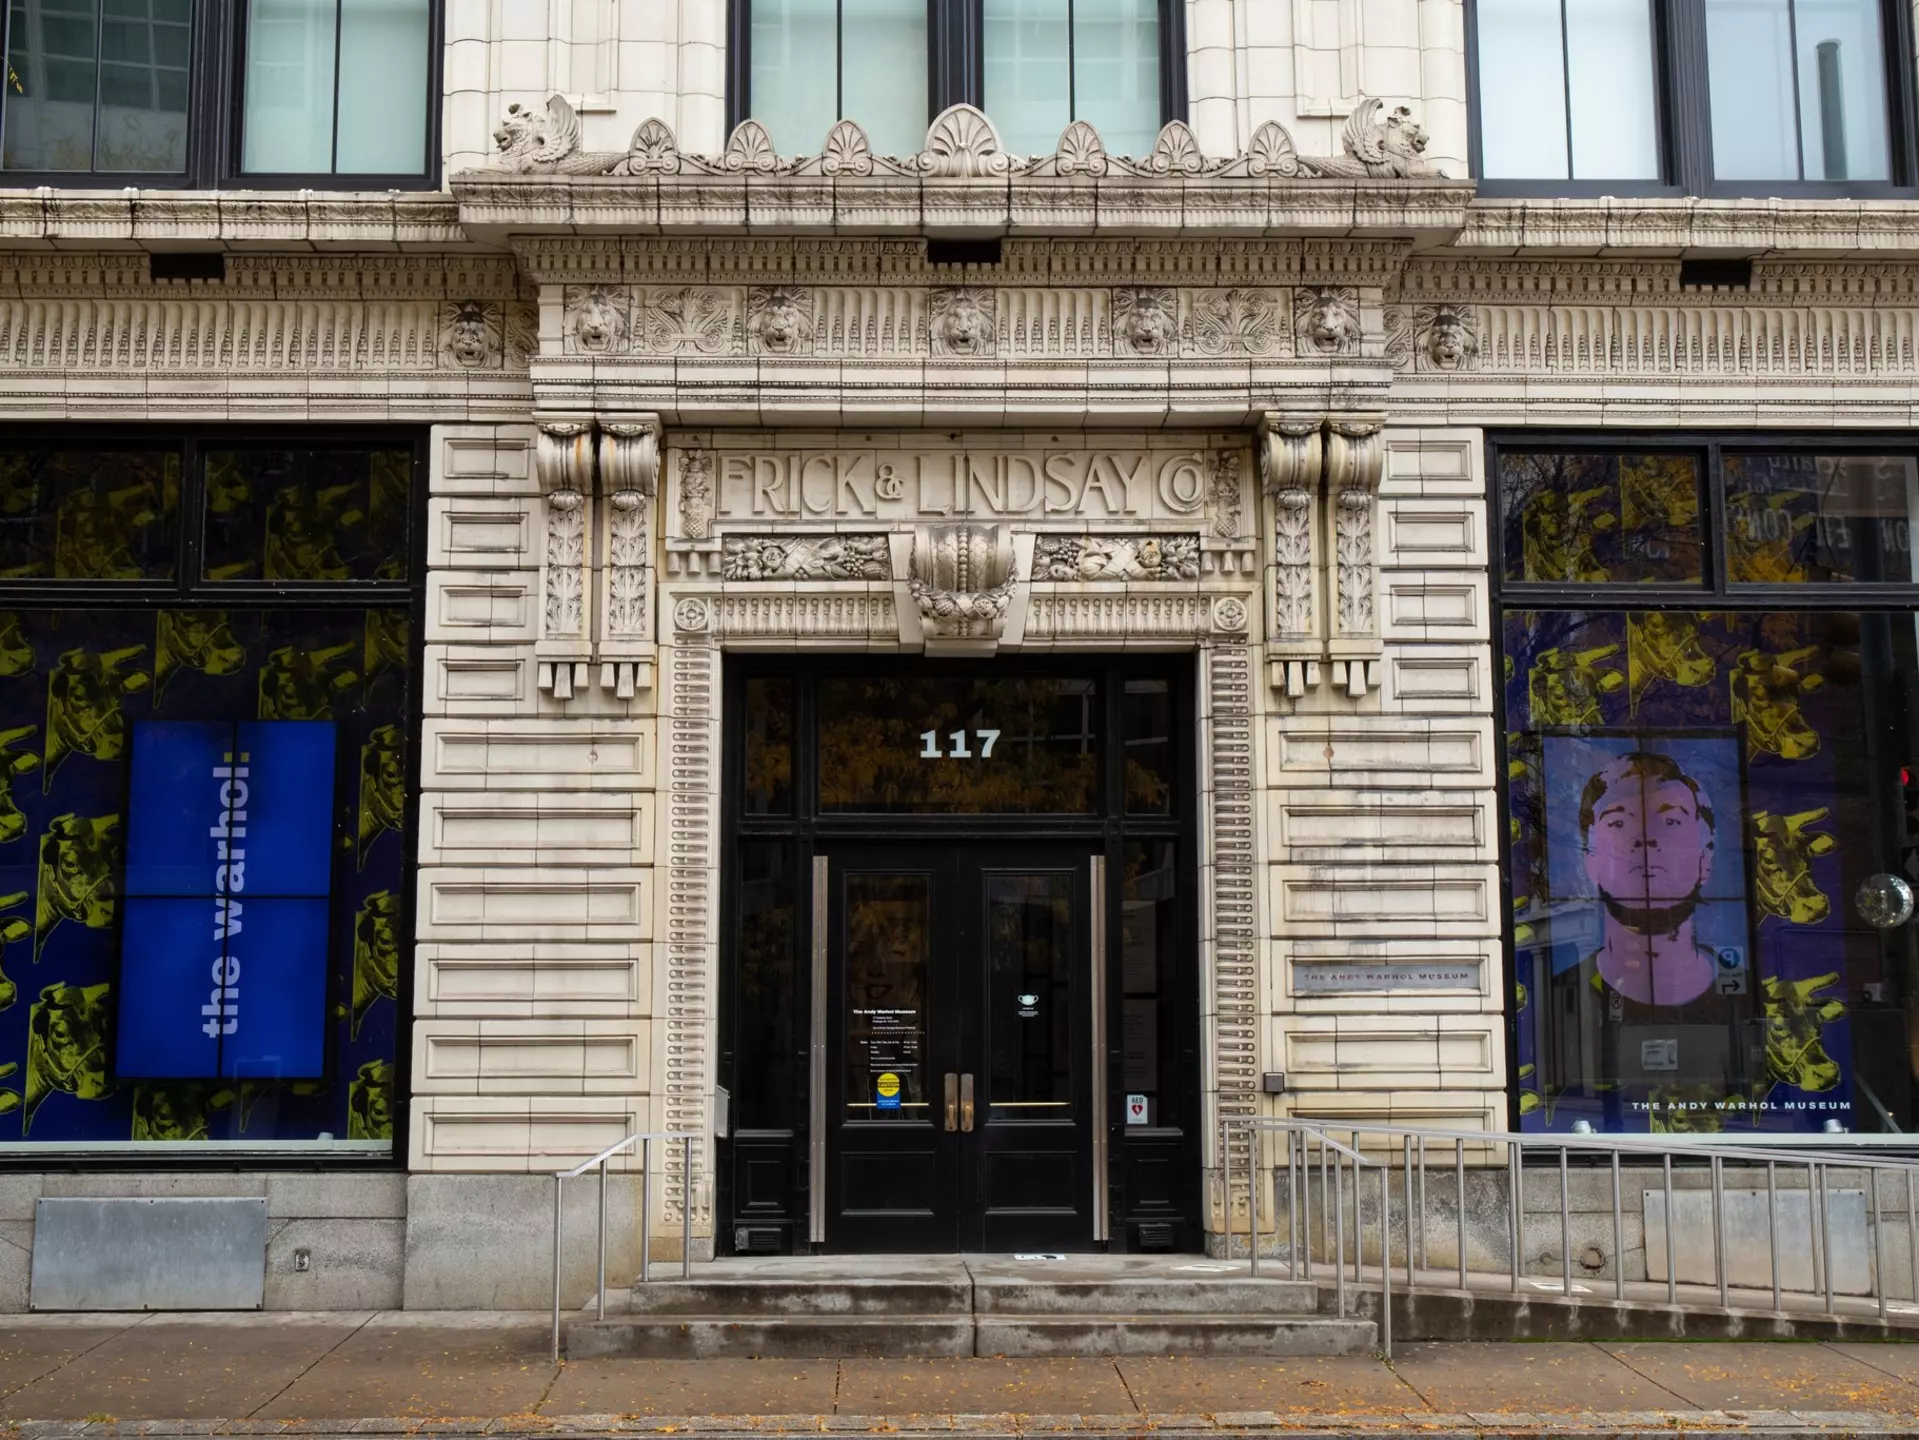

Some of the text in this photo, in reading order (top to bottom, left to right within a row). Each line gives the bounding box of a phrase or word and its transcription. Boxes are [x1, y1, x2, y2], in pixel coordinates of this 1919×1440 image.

[718, 453, 877, 514] FRICK
[875, 463, 905, 500] &
[916, 453, 1143, 516] LINDSAY
[920, 729, 1001, 758] 117
[1304, 974, 1325, 982] THE
[1366, 973, 1415, 981] WARHOL
[201, 955, 241, 1038] the
[1631, 1102, 1851, 1110] THE ANDY WARHOL MUSEUM
